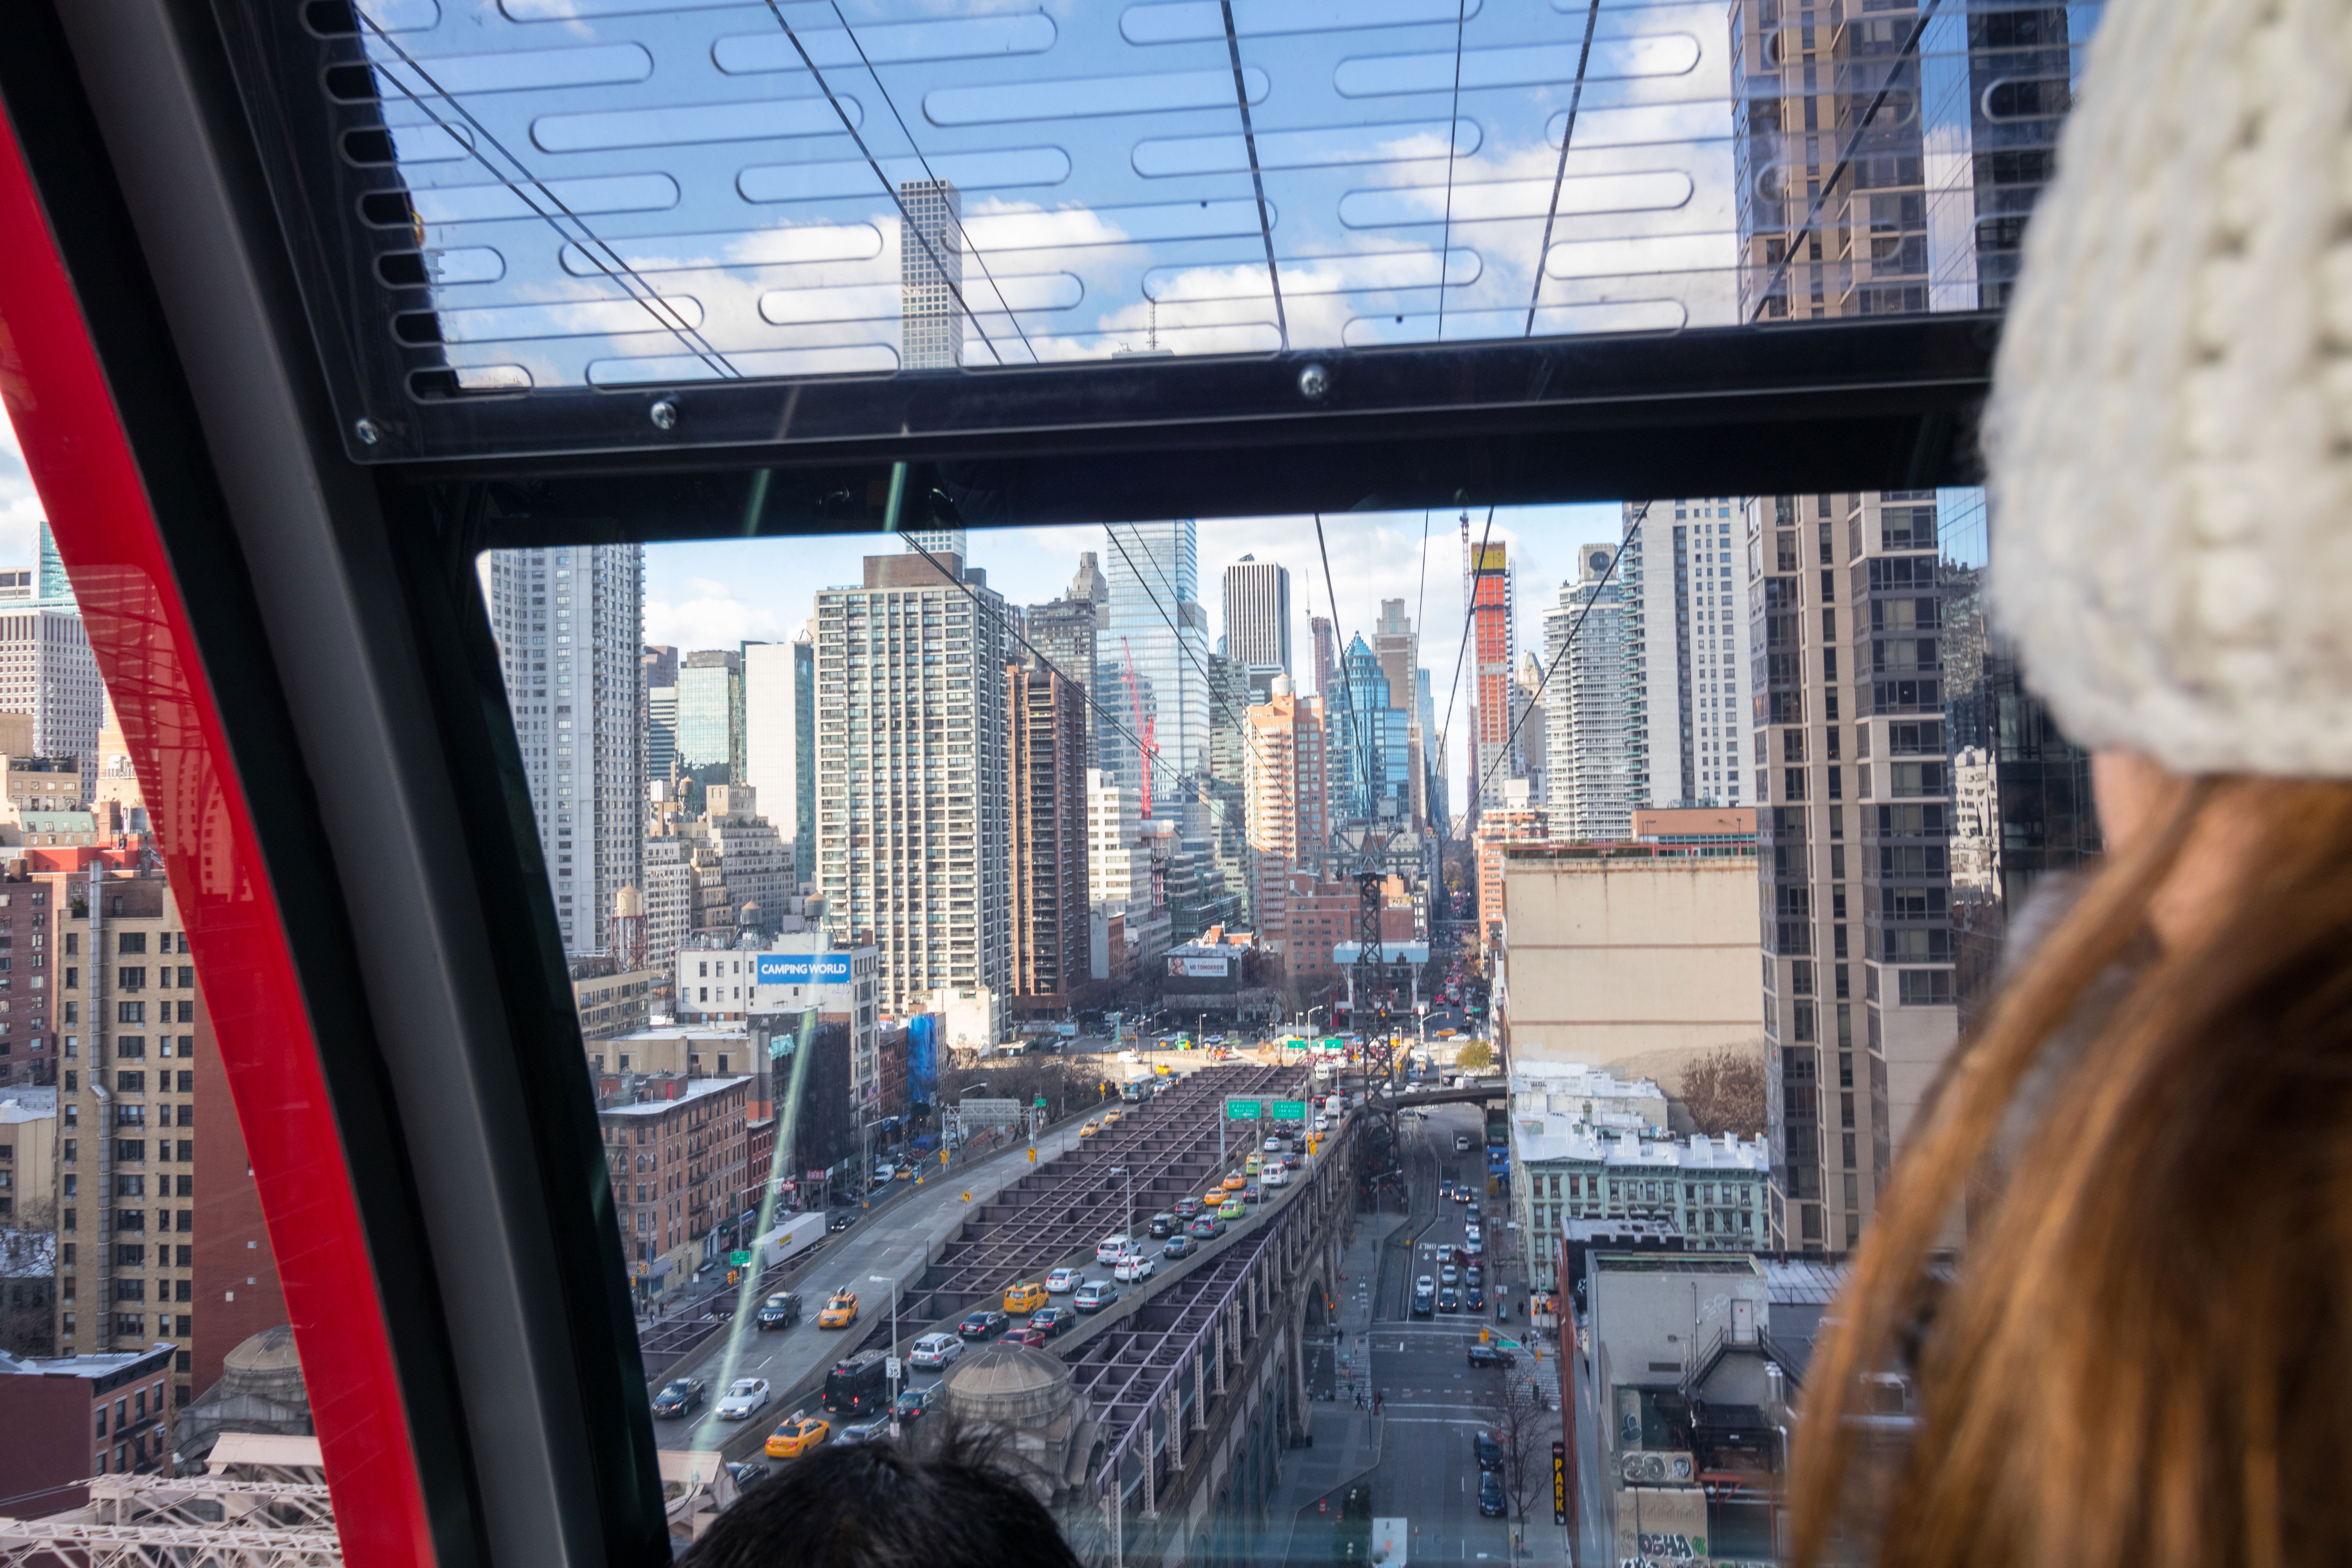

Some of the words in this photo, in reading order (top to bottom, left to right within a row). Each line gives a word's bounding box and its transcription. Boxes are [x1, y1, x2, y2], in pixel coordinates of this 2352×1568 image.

[761, 964, 808, 975] CAMPING
[809, 964, 846, 974] WORLD
[889, 1367, 899, 1376] 35
[1555, 1458, 1564, 1512] PARK
